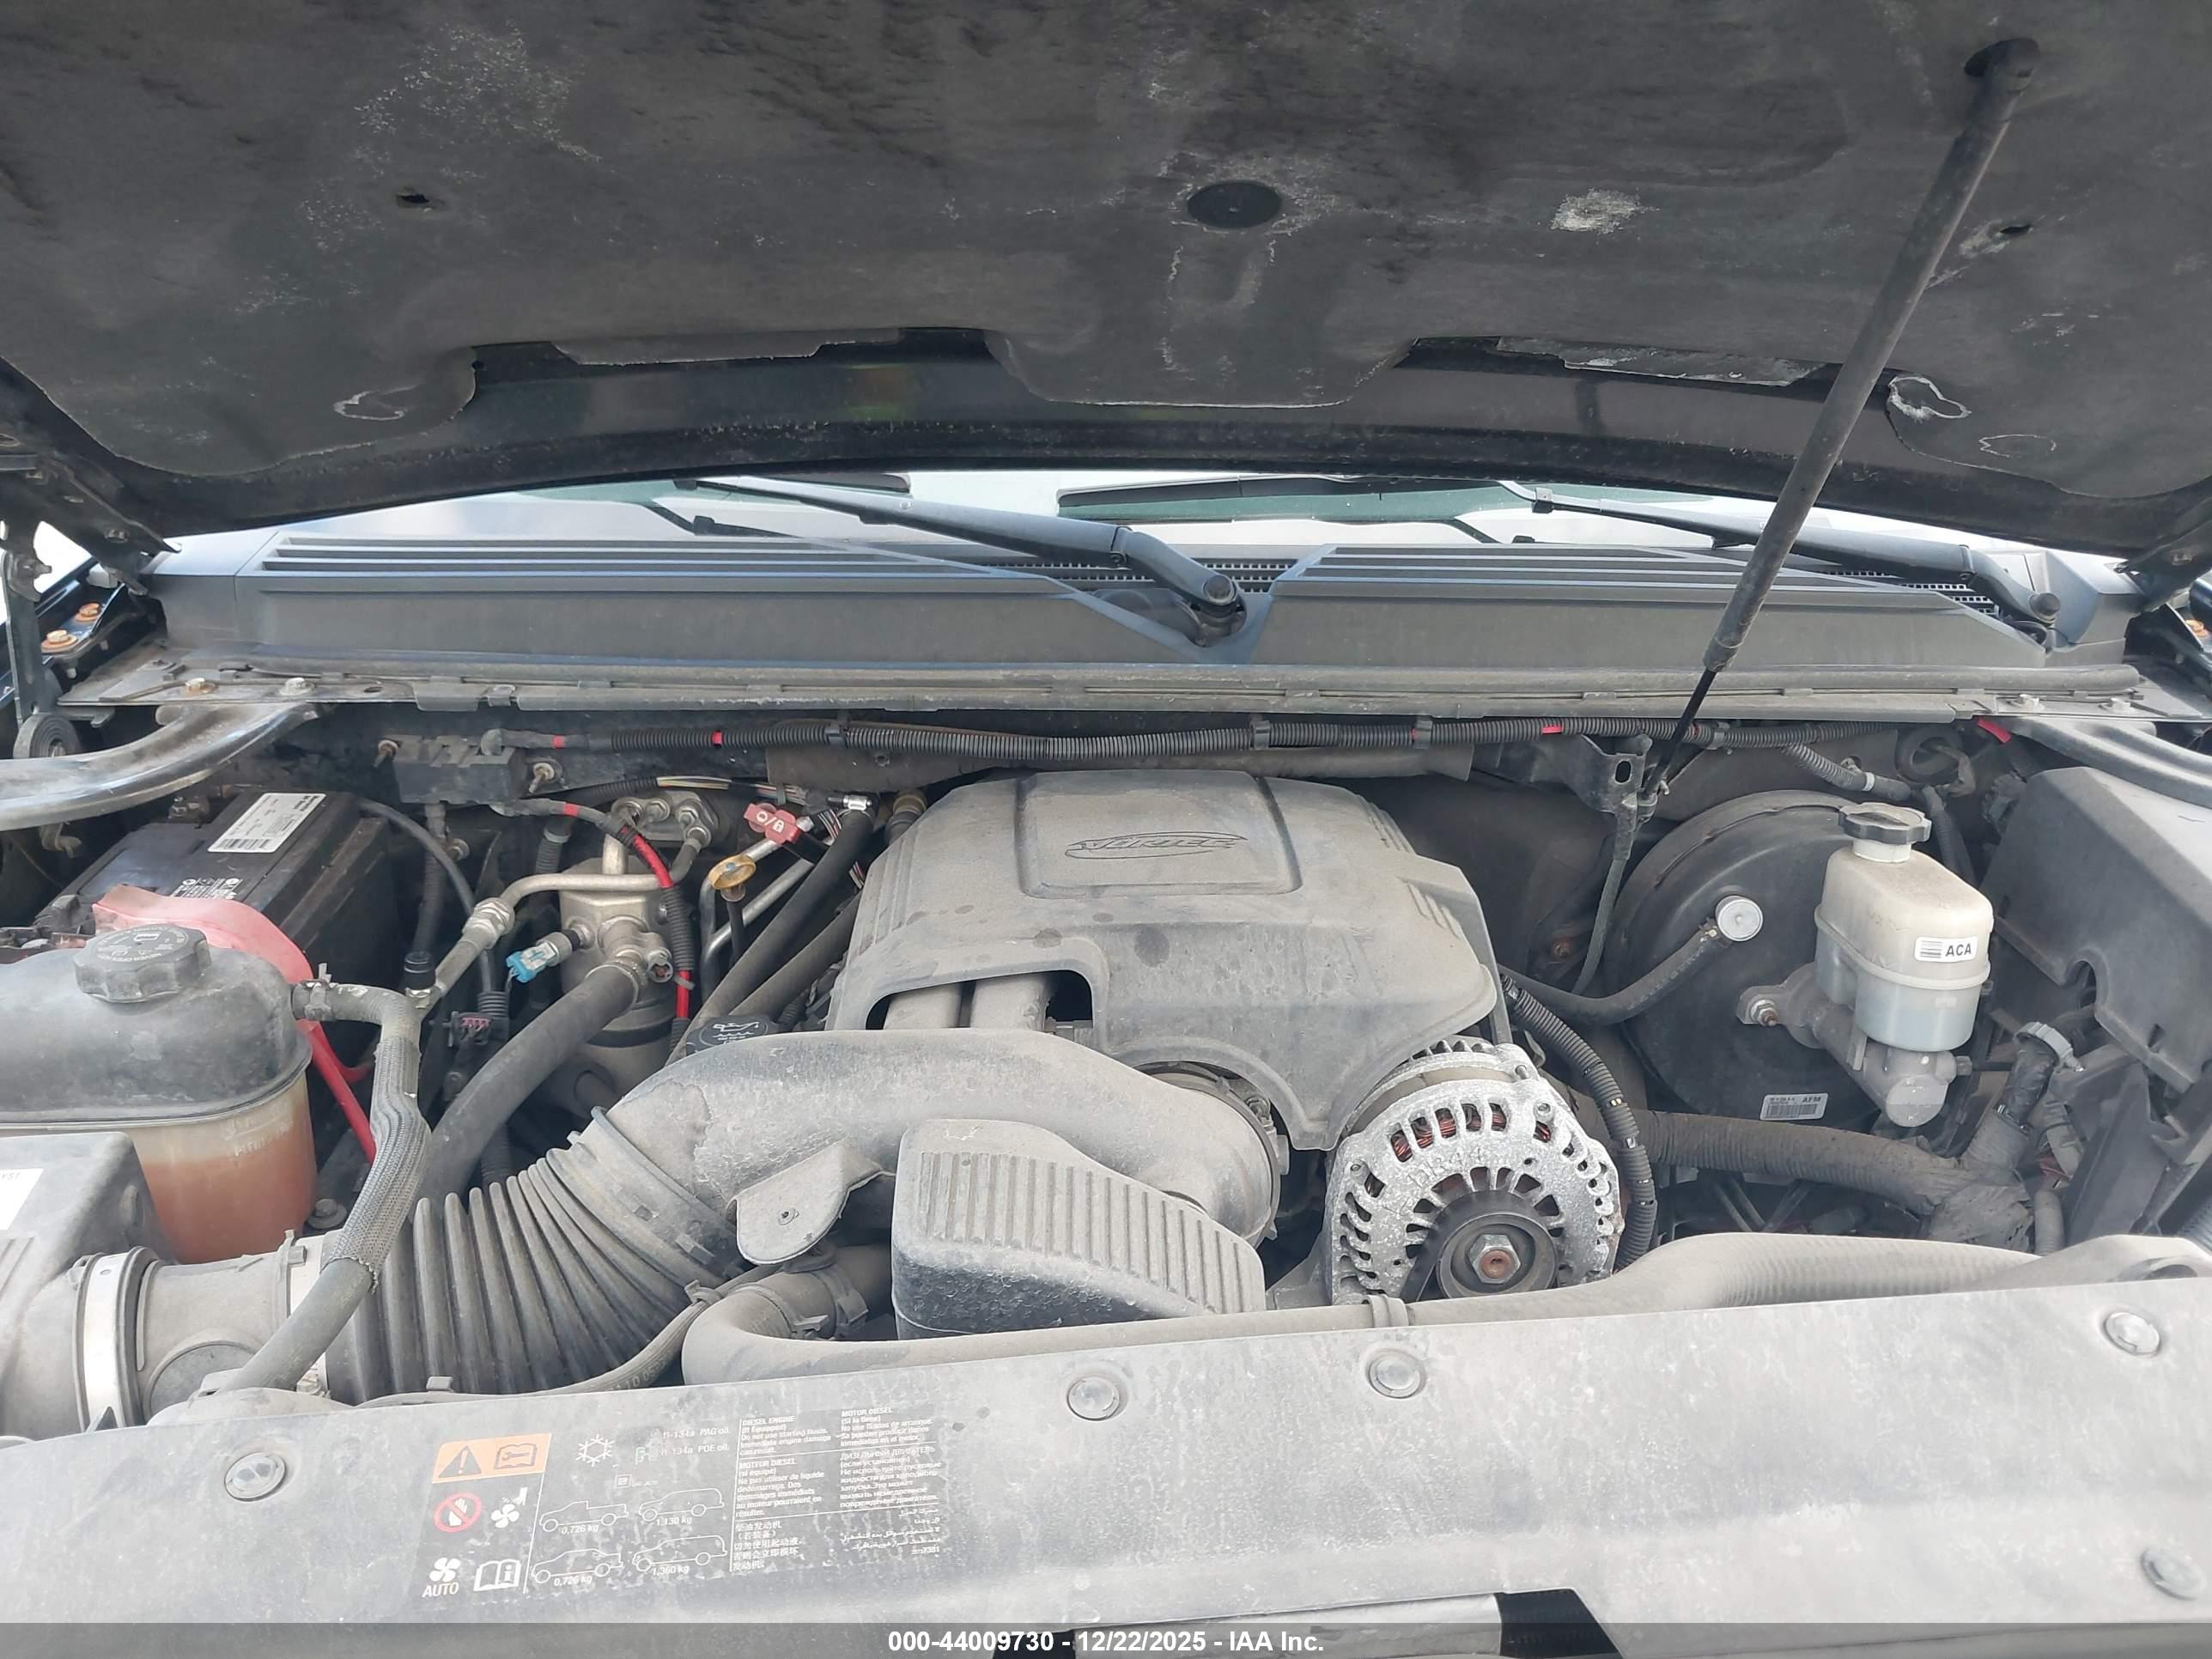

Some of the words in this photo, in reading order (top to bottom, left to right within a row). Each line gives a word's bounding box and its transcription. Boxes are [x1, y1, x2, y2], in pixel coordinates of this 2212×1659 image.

[1945, 944, 1972, 957] ACA
[841, 1408, 866, 1417] MOTOR
[700, 1428, 717, 1437] PAG
[697, 1444, 715, 1454] POE
[738, 1460, 769, 1468] MOTEUR
[770, 1457, 797, 1466] DIESEL
[681, 1516, 692, 1525] kg
[587, 1524, 599, 1533] kg
[678, 1565, 690, 1574] kg
[580, 1575, 592, 1584] kg
[422, 1582, 459, 1598] AUTO
